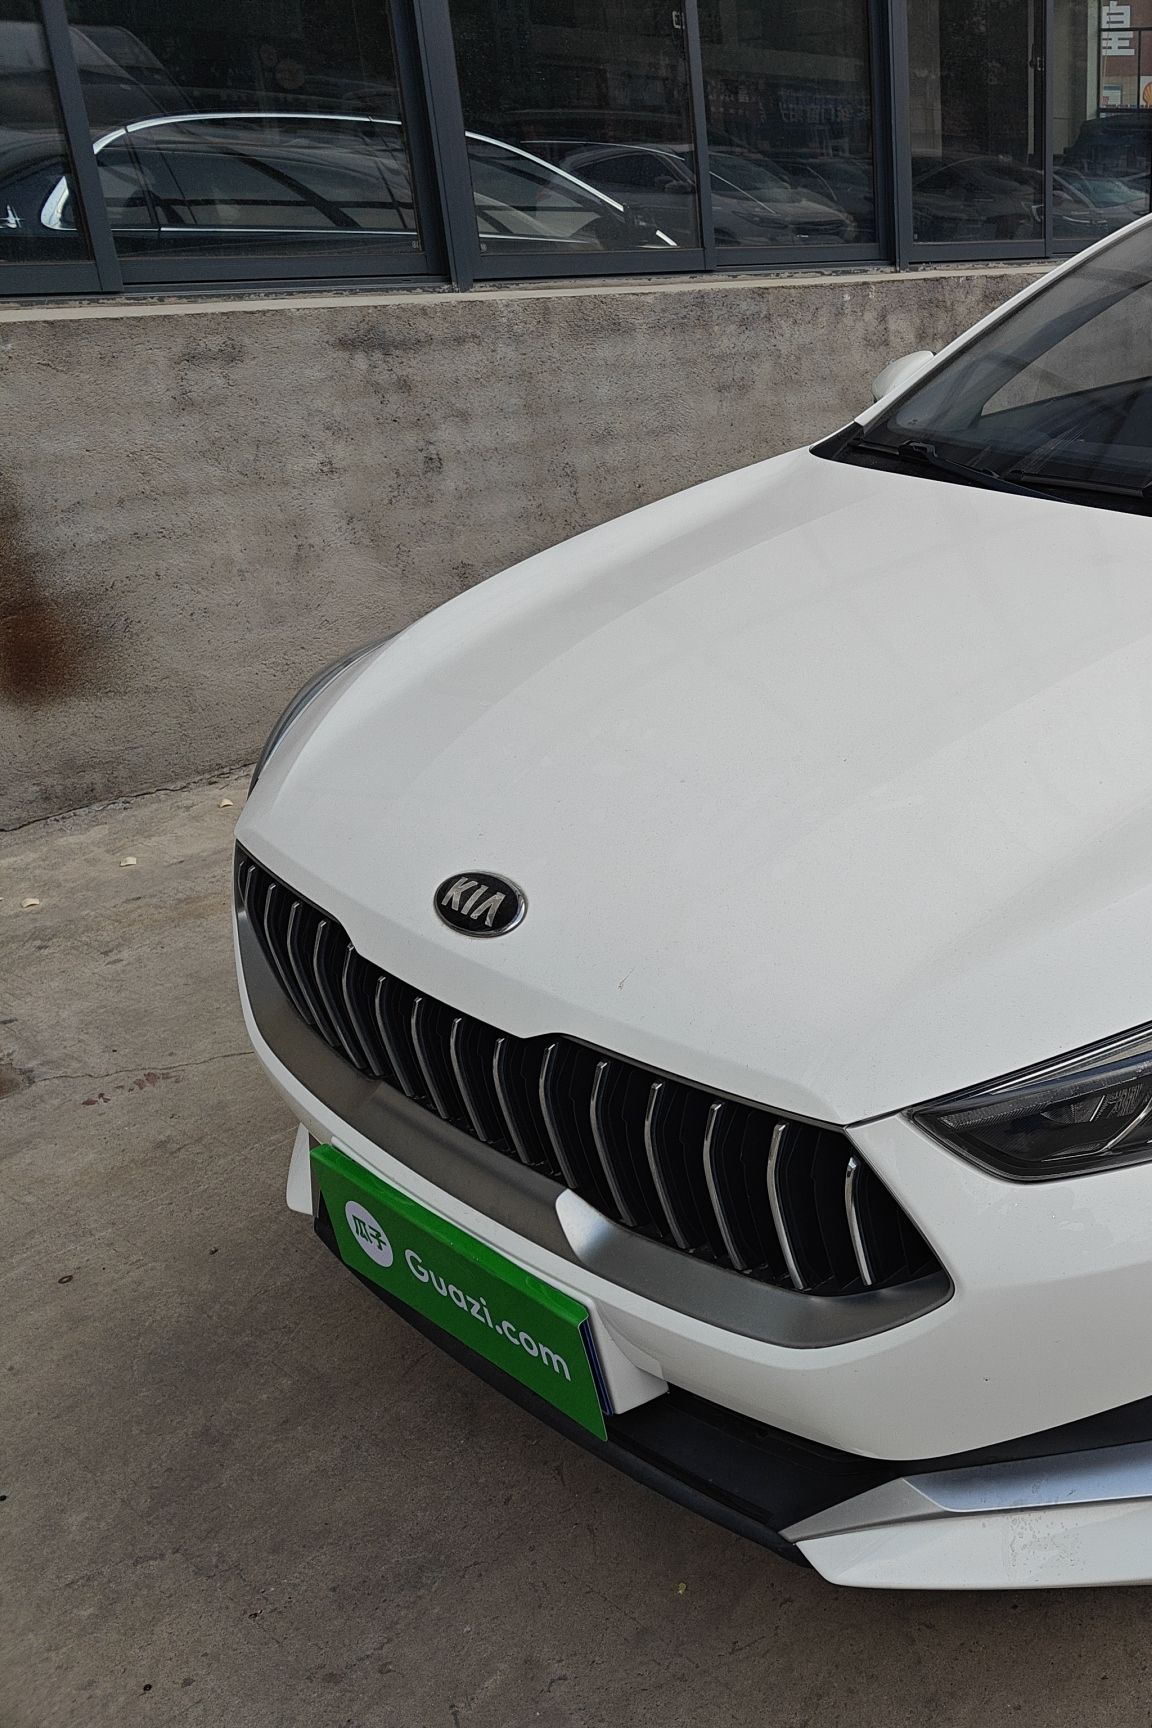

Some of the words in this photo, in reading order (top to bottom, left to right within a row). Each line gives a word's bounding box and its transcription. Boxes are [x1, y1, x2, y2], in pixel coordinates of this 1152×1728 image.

[441, 876, 506, 928] KIA
[352, 1214, 388, 1252] 瓜子
[405, 1248, 571, 1382] Guazi.com
